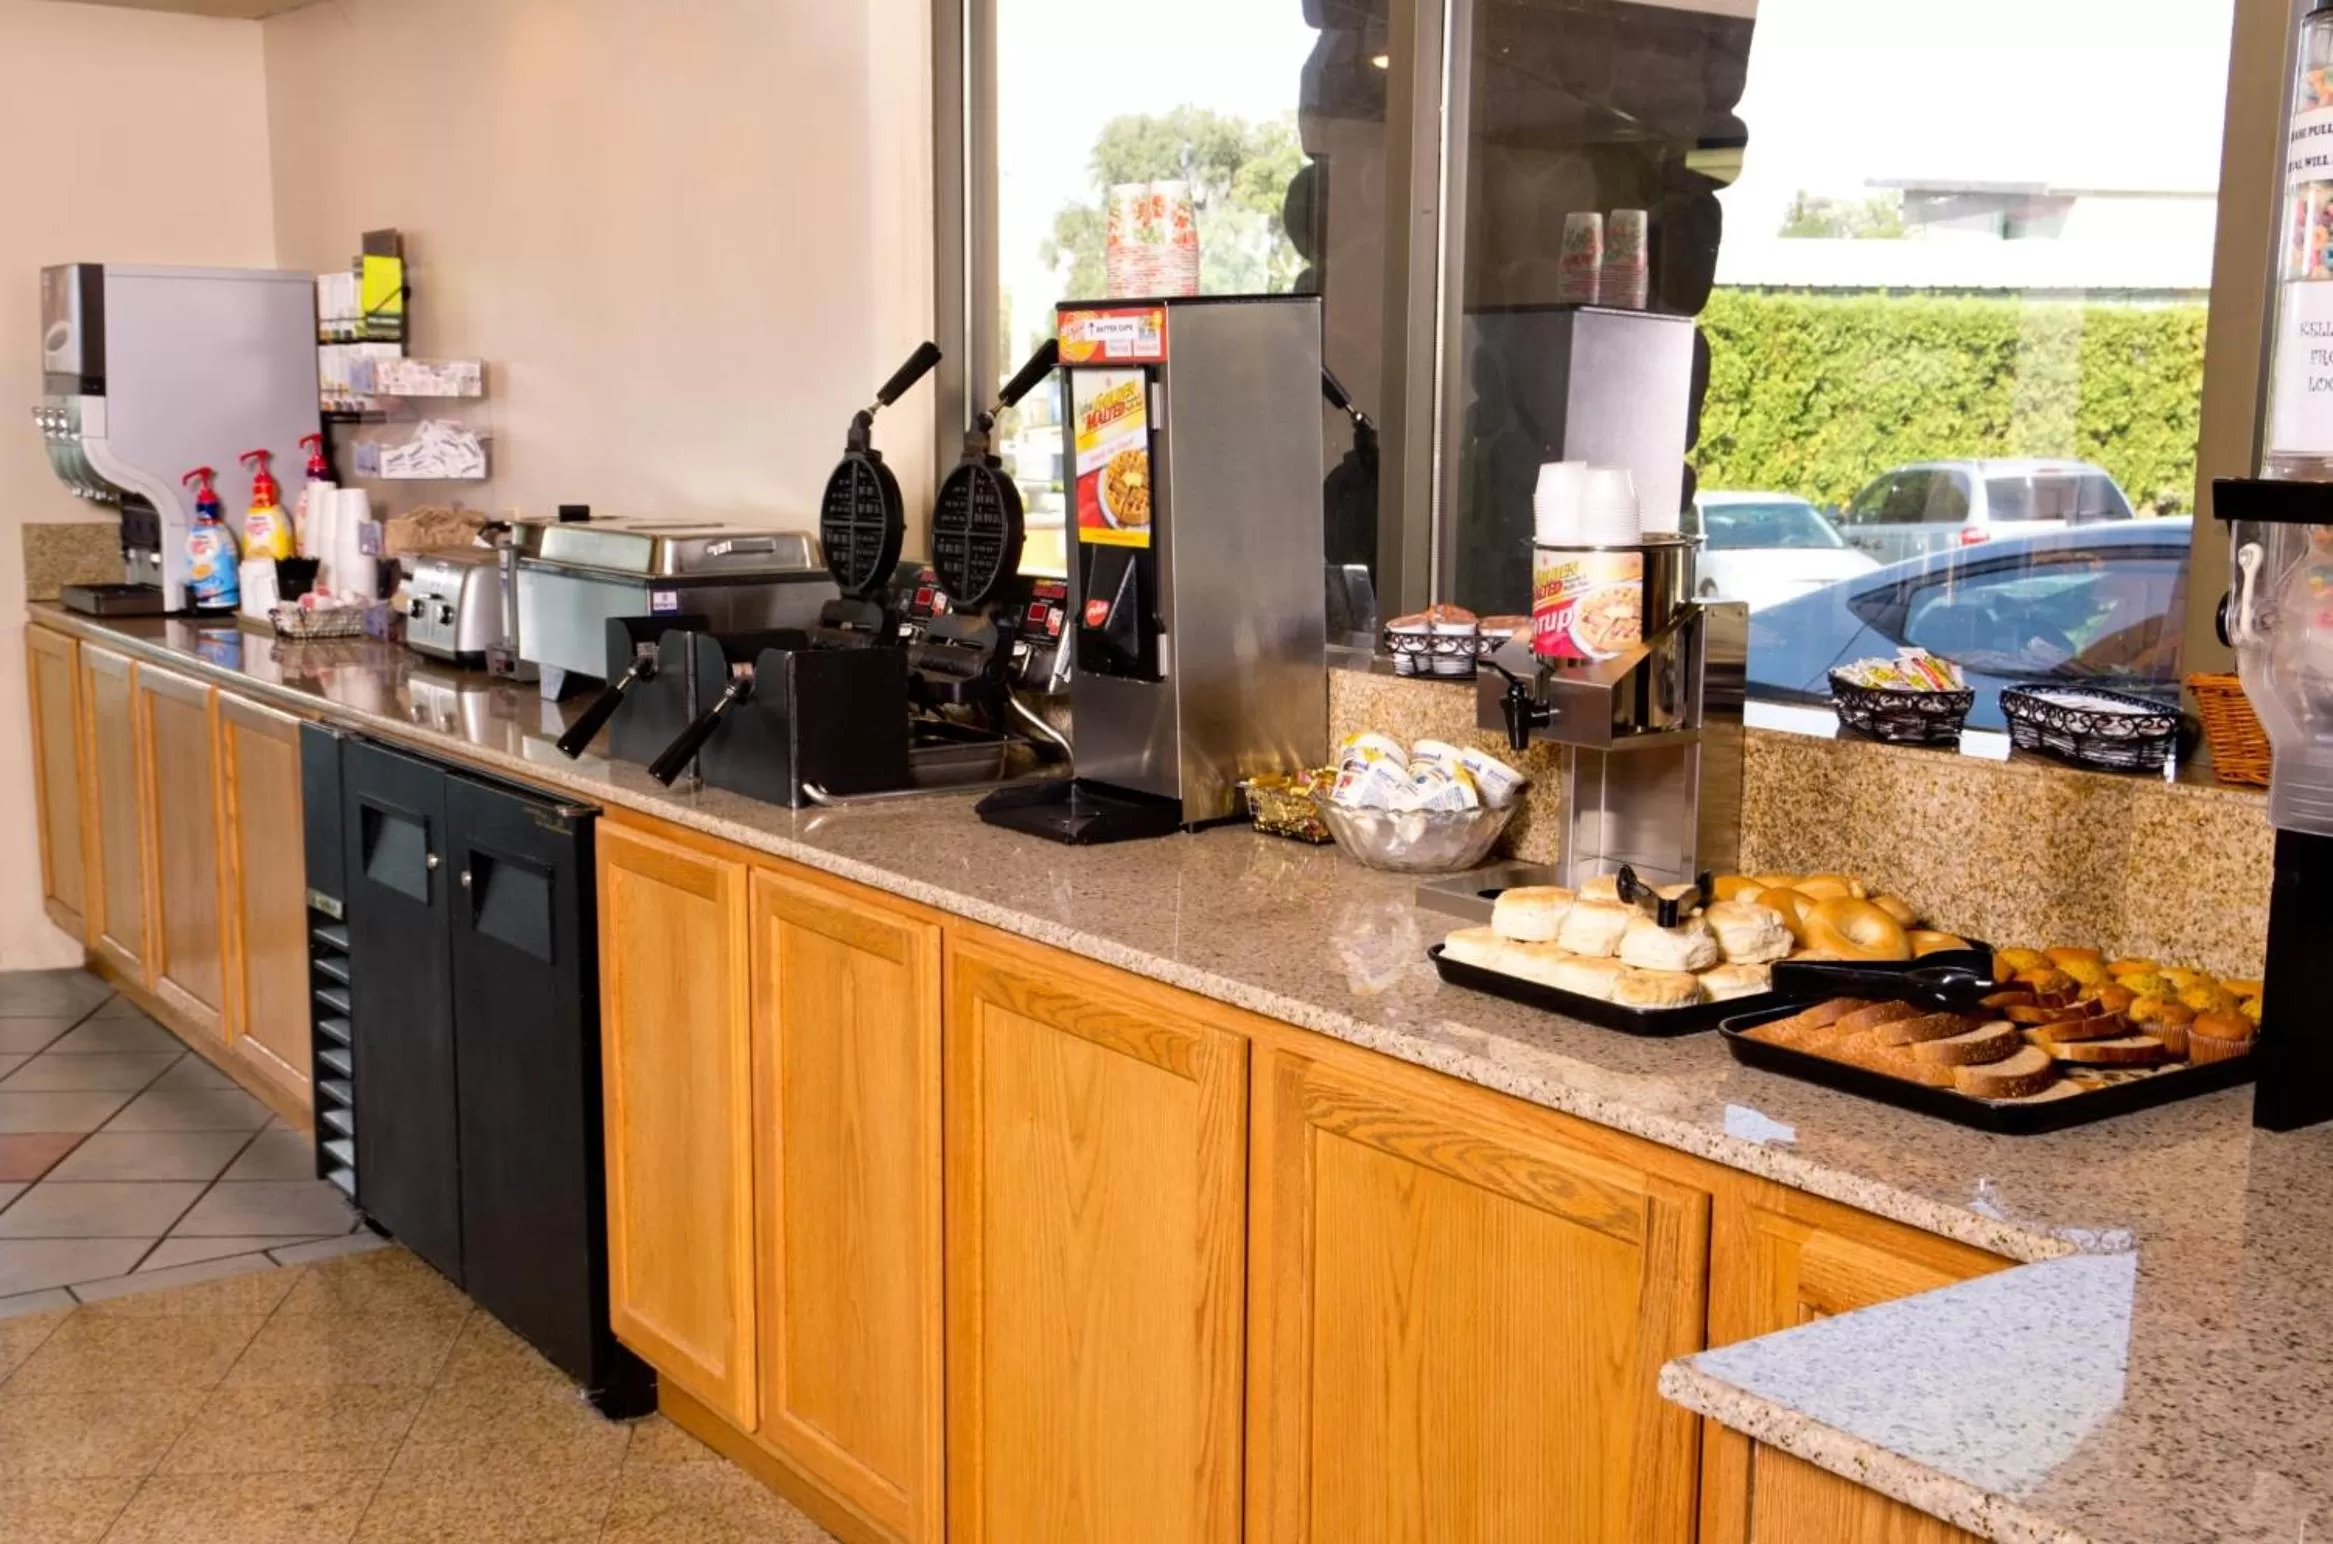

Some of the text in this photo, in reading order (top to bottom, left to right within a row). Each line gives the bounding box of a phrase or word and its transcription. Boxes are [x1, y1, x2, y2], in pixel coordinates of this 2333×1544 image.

[2308, 123, 2333, 137] PULL
[2304, 154, 2328, 167] WILL
[1085, 400, 1126, 432] MALTED
